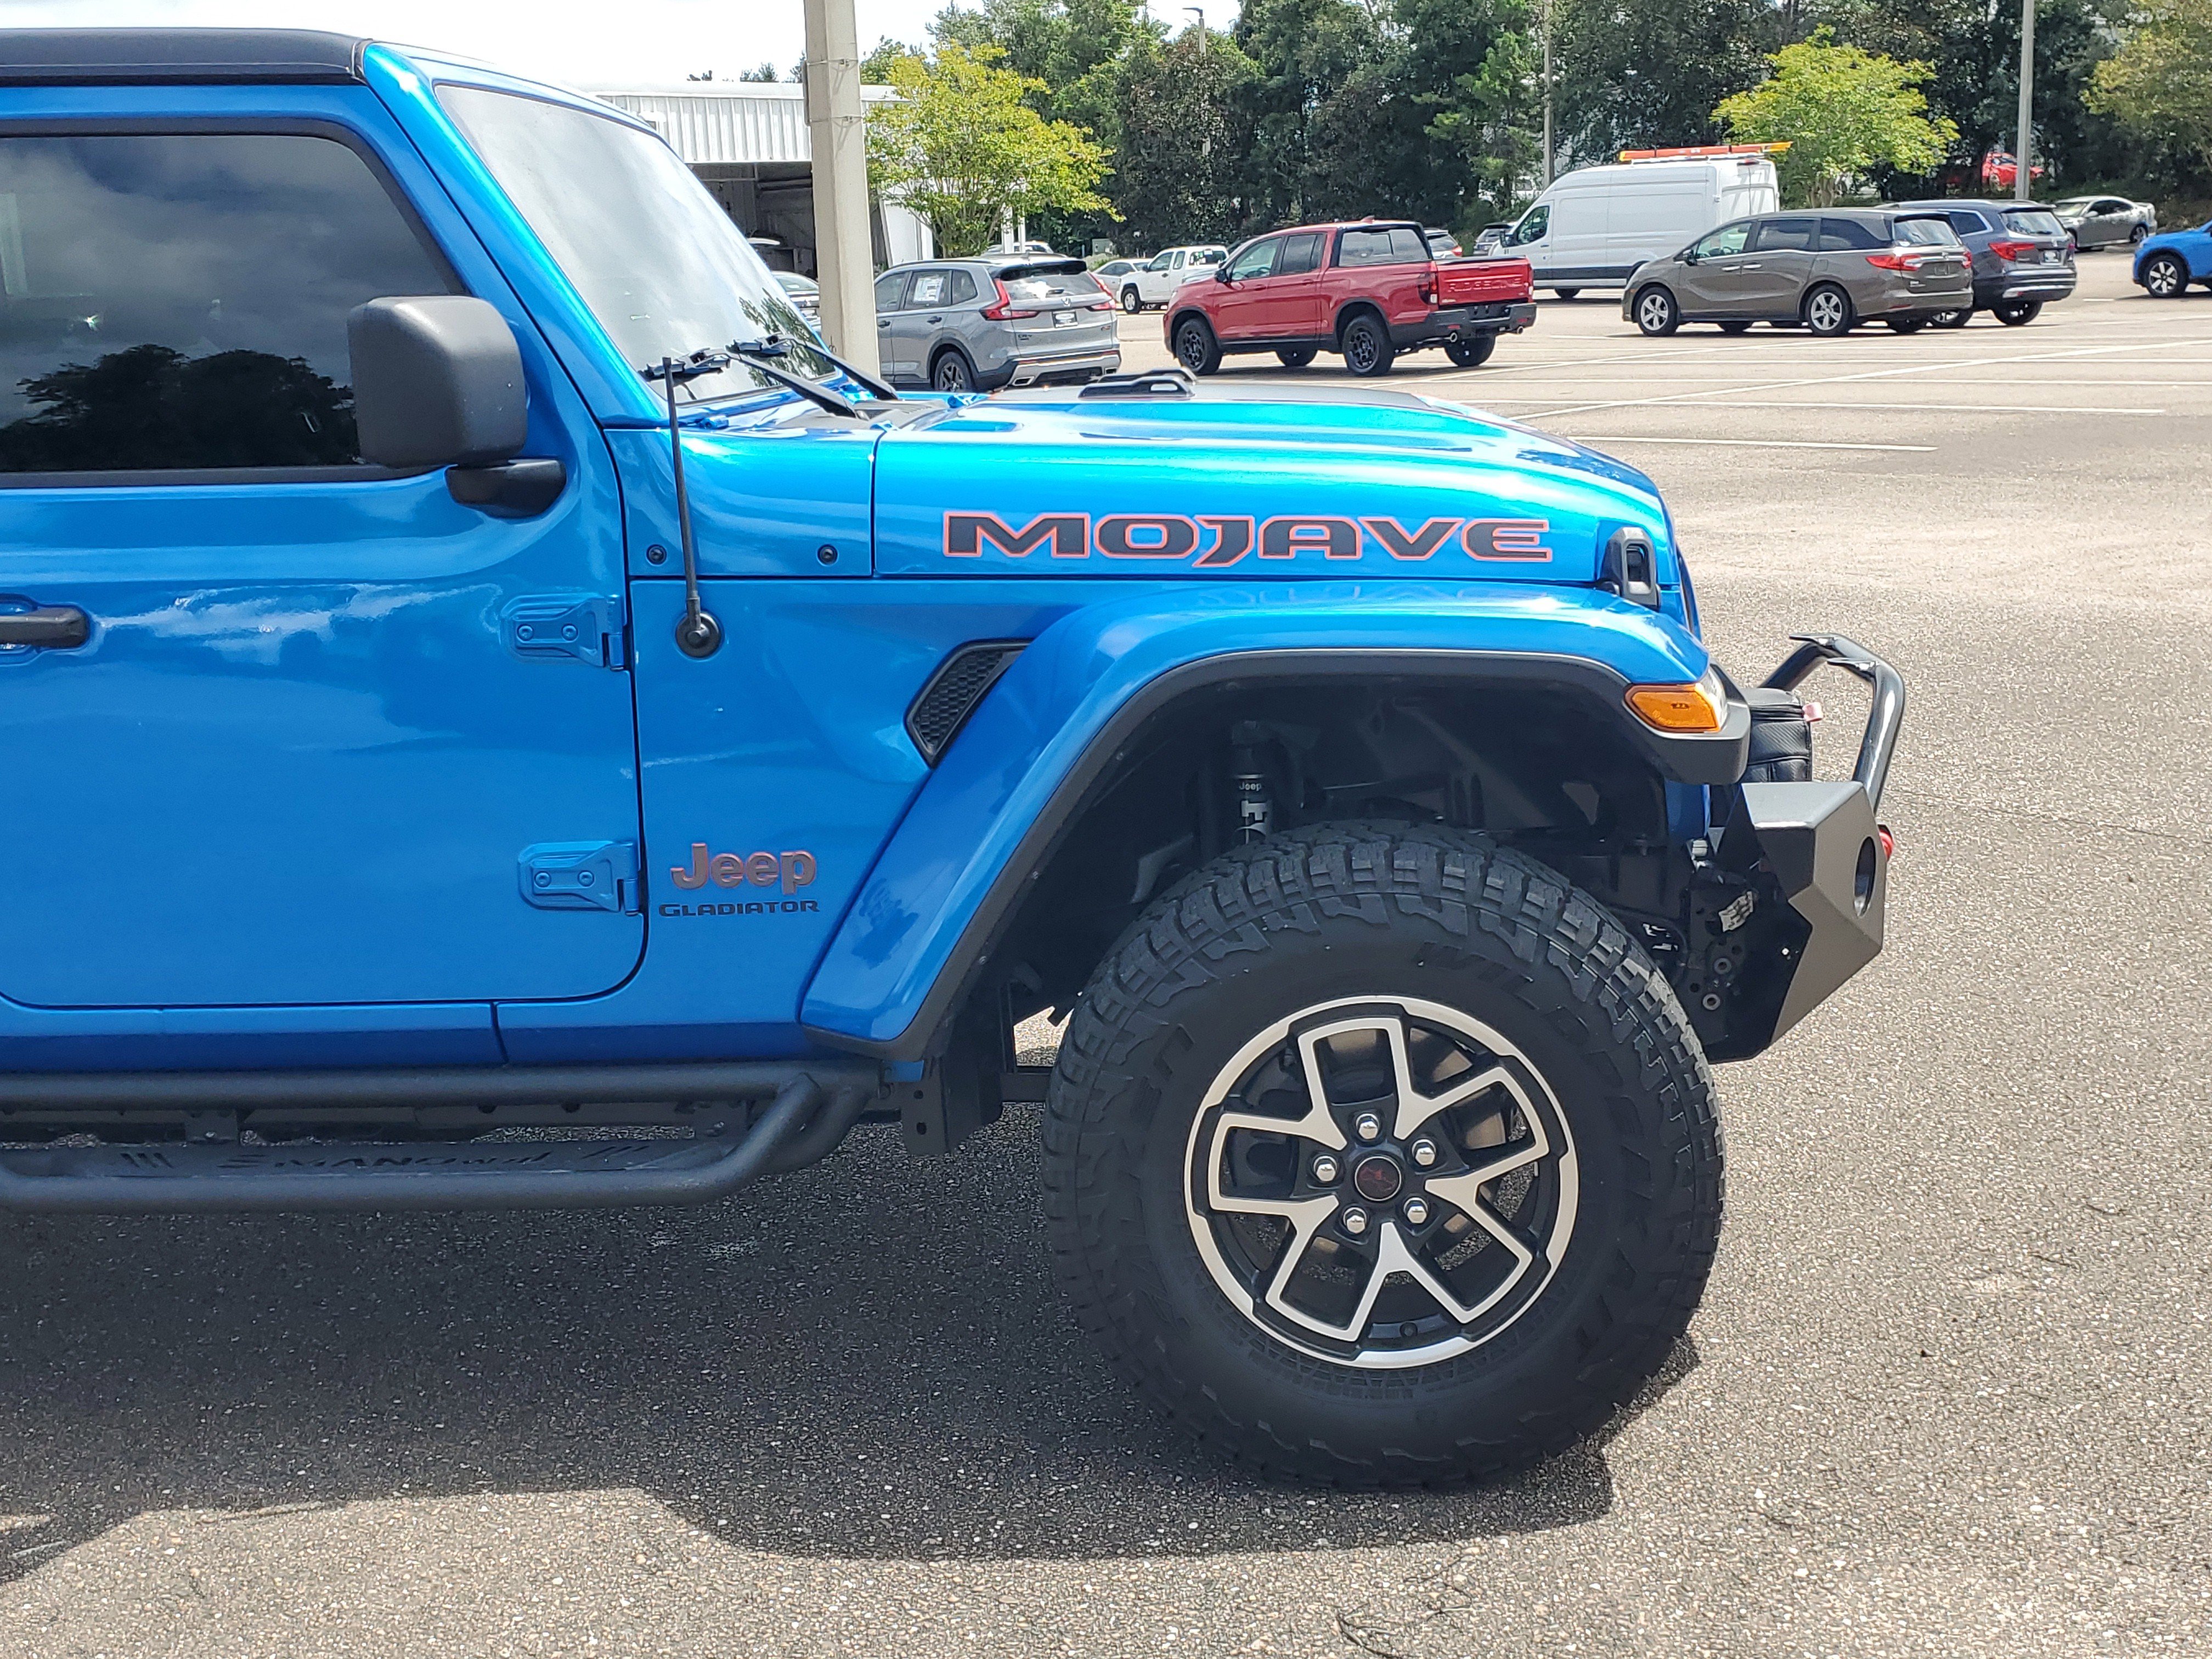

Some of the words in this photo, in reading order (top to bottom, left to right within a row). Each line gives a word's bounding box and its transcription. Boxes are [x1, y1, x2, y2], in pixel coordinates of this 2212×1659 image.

[944, 512, 1553, 567] MOJAVE
[1239, 782, 1262, 791] Jeep
[670, 843, 816, 895] Jeep
[659, 900, 820, 917] GLADIATOR
